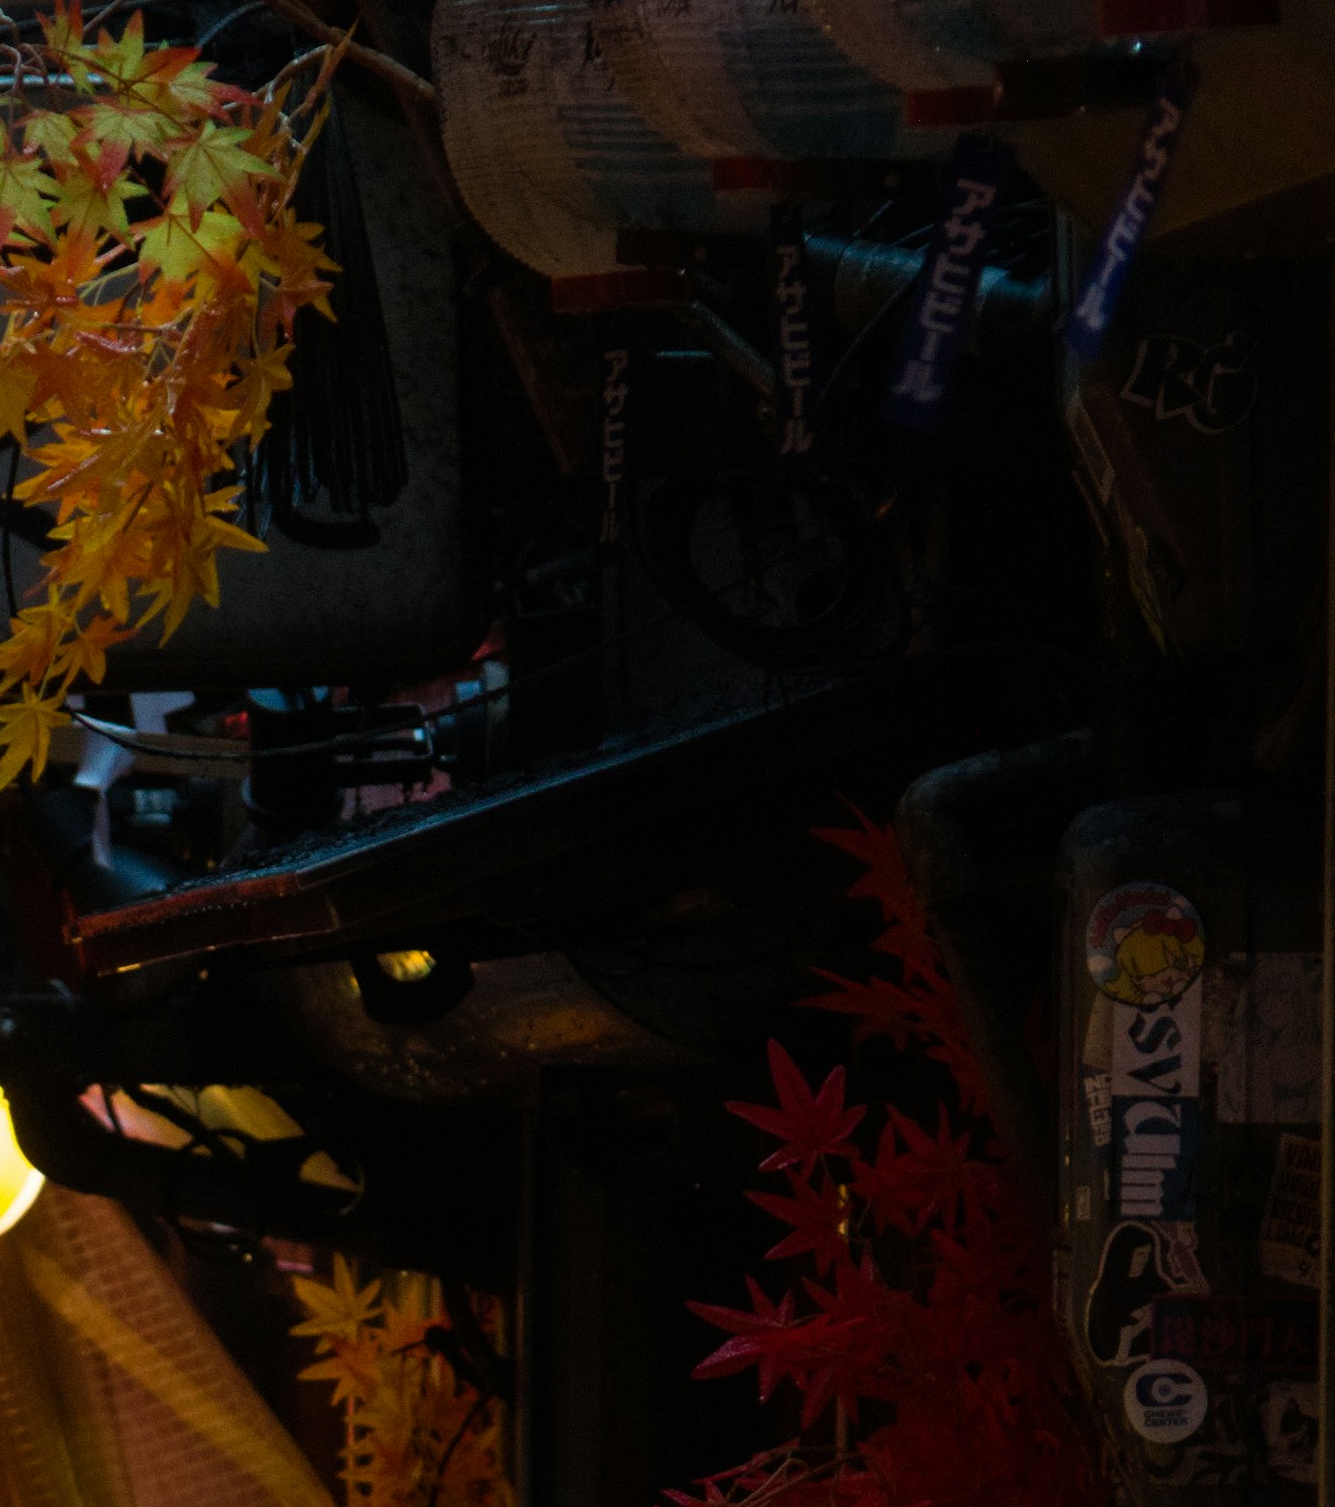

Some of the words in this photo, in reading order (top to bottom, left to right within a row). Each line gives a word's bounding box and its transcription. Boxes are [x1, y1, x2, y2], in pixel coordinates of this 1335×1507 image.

[774, 243, 815, 456] アサヒビール
[890, 177, 999, 403] アサヒビール
[1128, 998, 1183, 1096] SV
